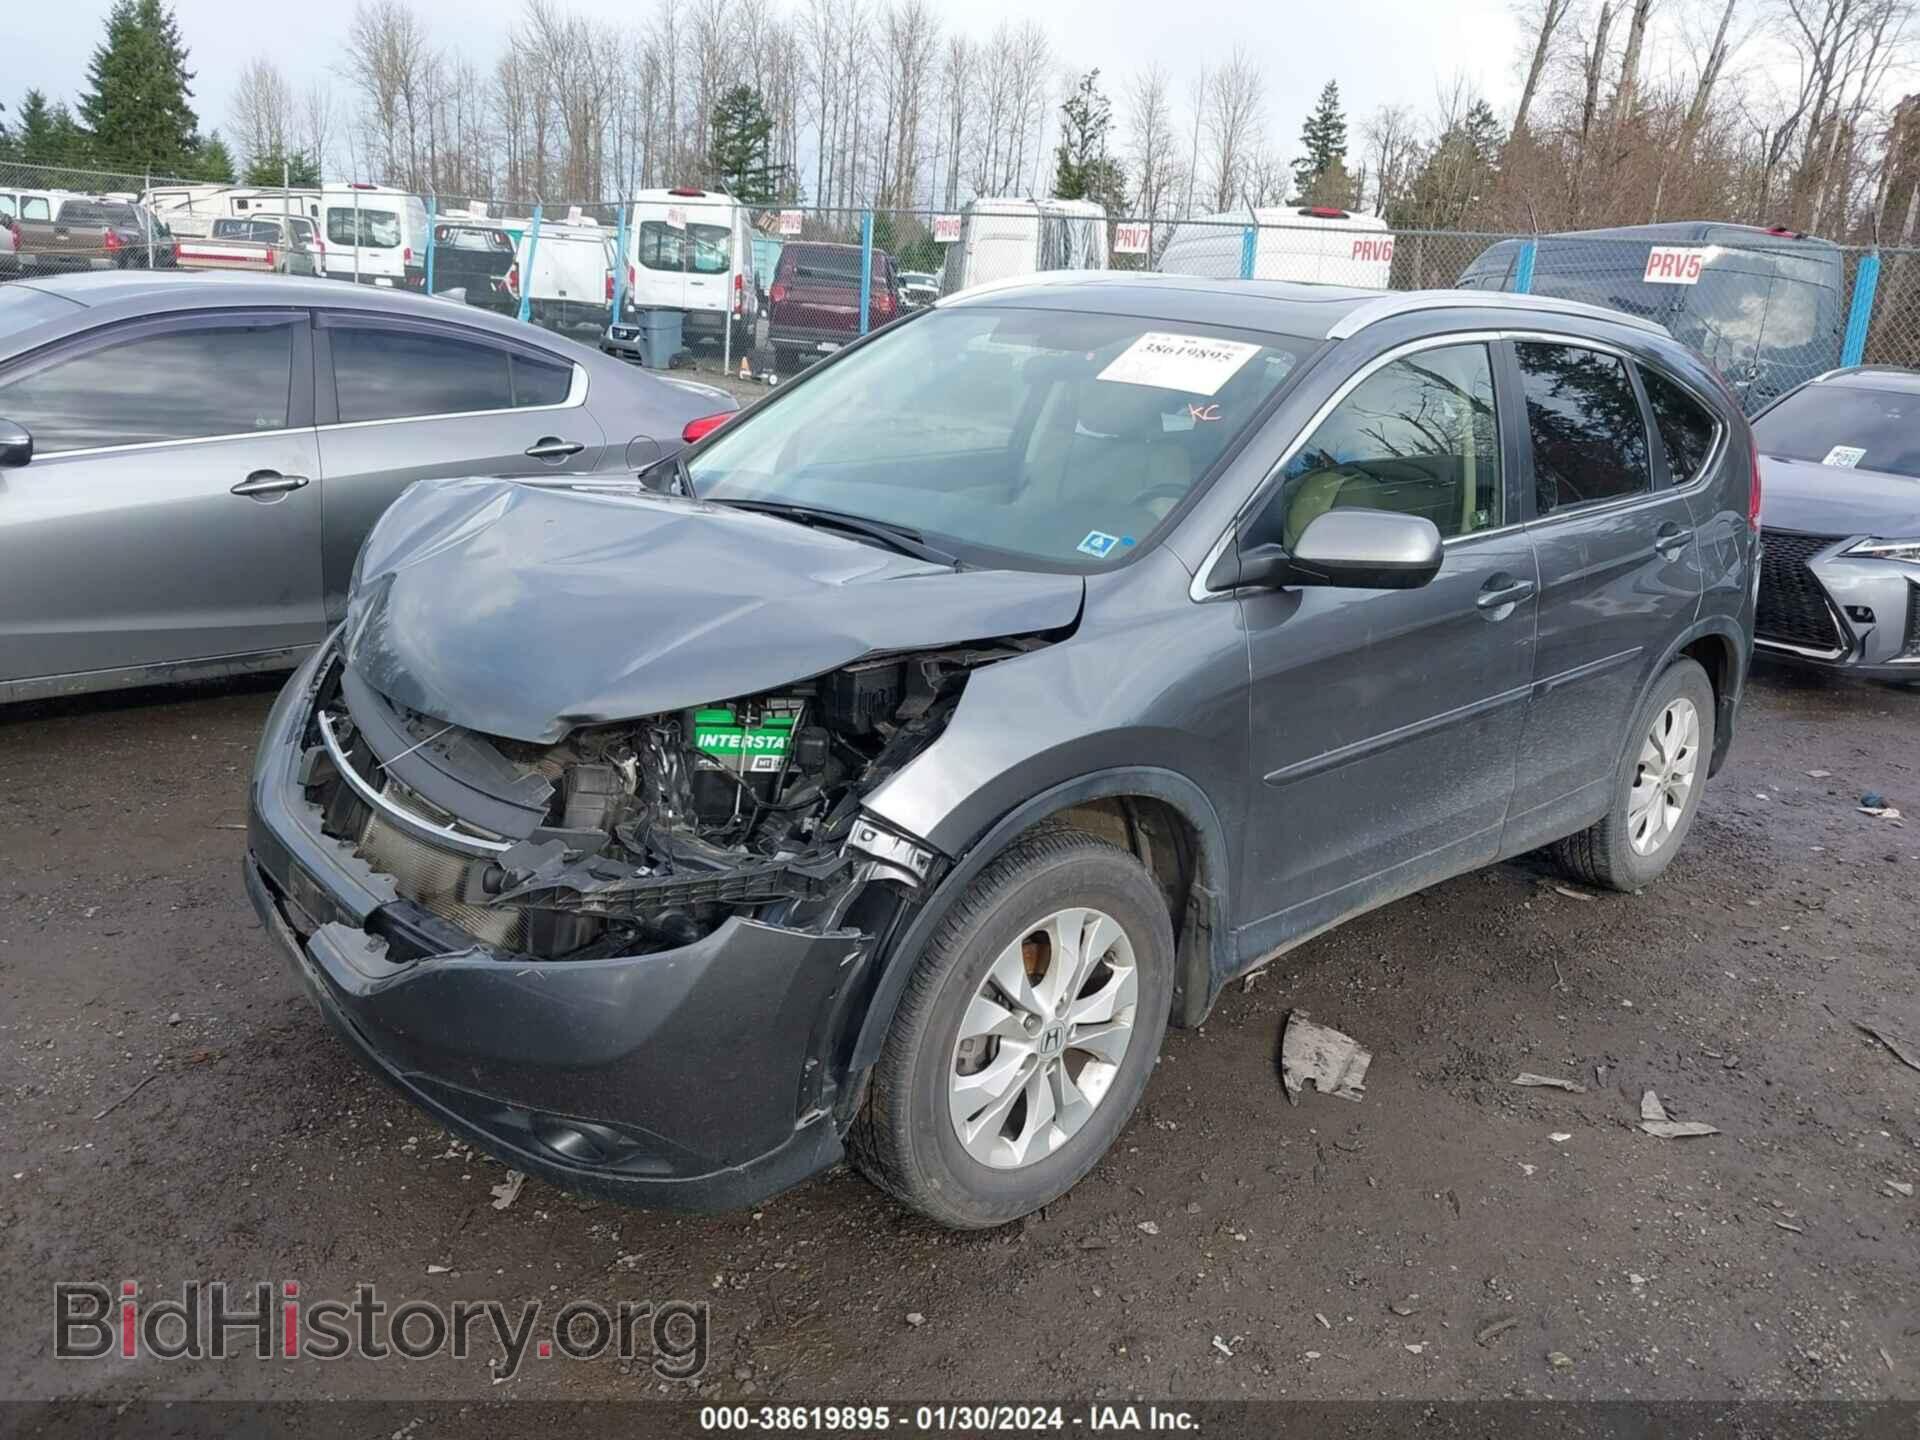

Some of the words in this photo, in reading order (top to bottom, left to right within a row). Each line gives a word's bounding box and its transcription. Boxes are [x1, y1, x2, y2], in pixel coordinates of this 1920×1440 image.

[934, 218, 961, 236] PRV8
[1115, 227, 1149, 248] PRV7
[1351, 240, 1393, 261] PRV6
[1647, 253, 1702, 277] PRV5
[1188, 403, 1223, 421] KC
